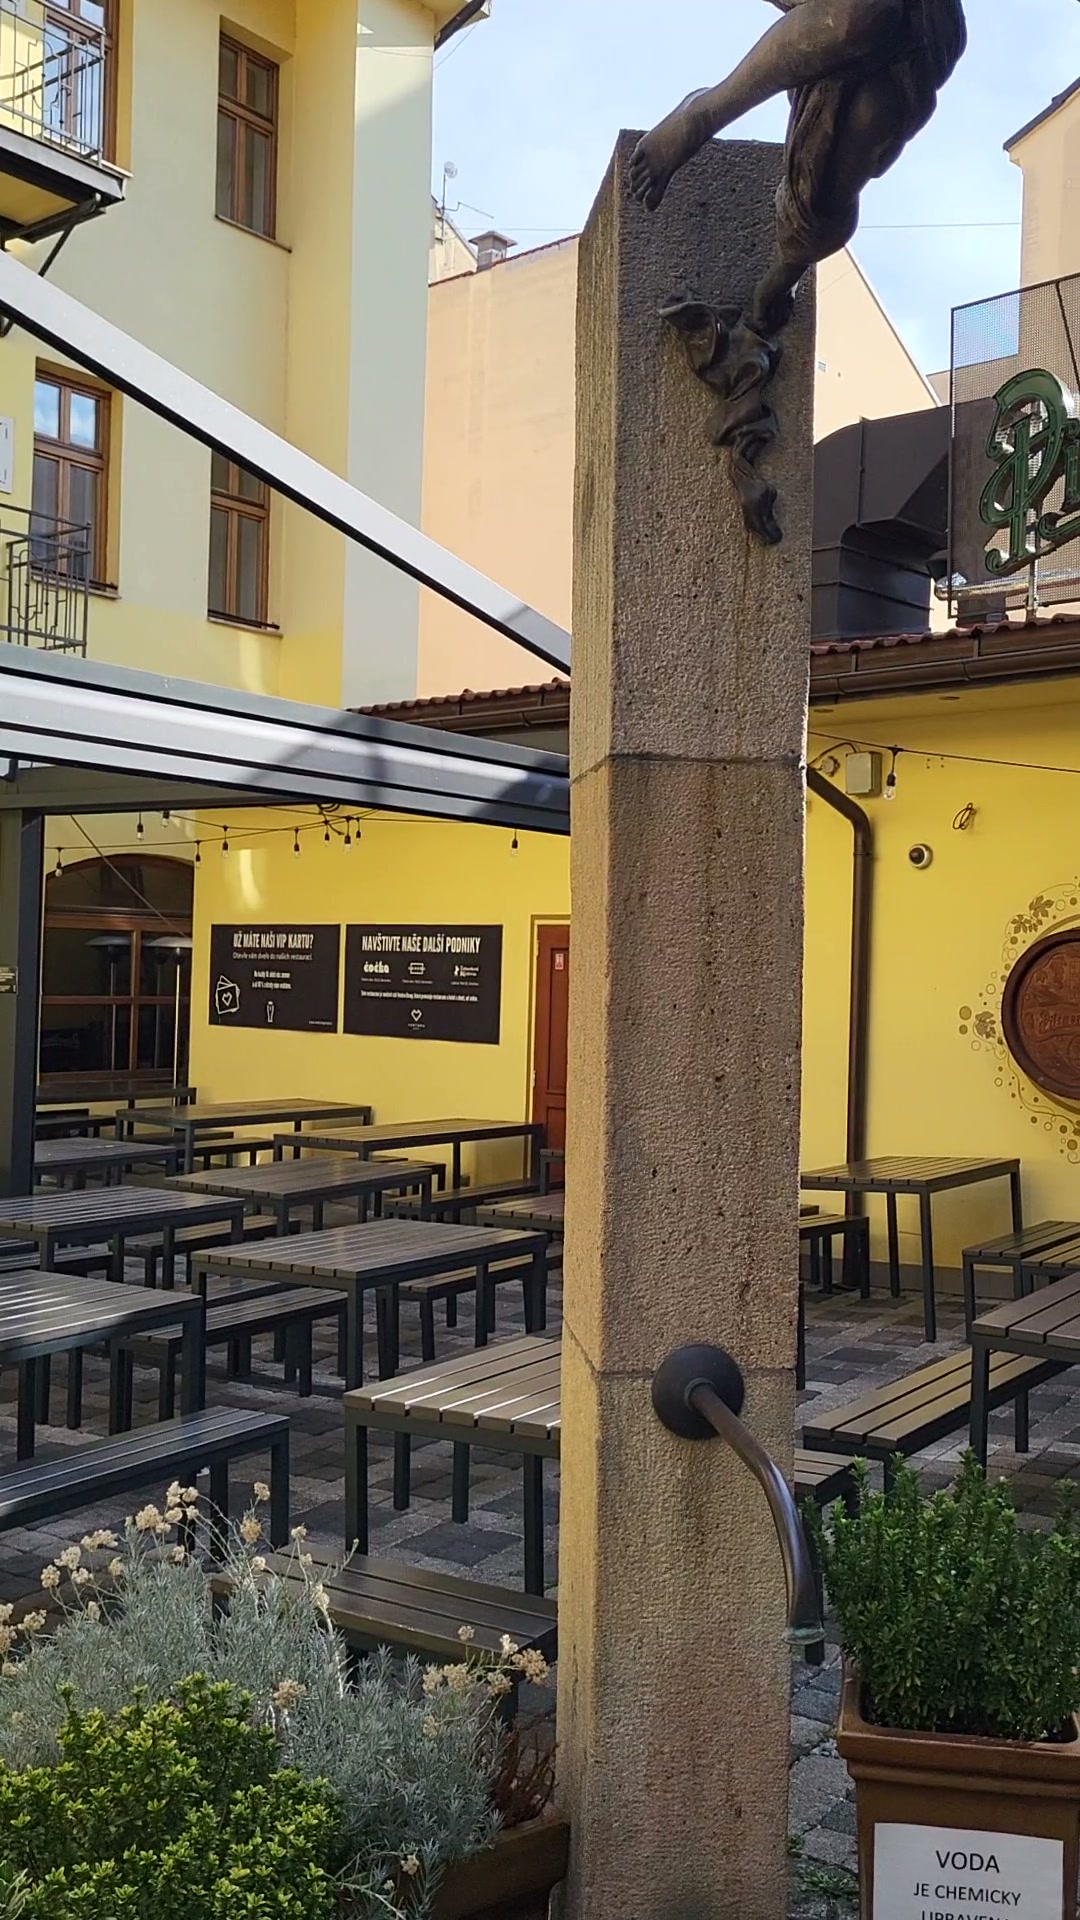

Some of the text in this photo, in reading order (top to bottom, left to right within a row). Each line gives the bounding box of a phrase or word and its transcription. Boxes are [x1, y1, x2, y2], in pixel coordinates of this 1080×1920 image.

[233, 929, 314, 949] UŽ MÁTE NAŠI VIP KARTU?
[361, 933, 481, 953] NAVŠTIVTE NAŠE DALŠÍ PODNIKY
[936, 1850, 1000, 1873] VODA
[913, 1882, 1021, 1906] JE CHEMICKY
